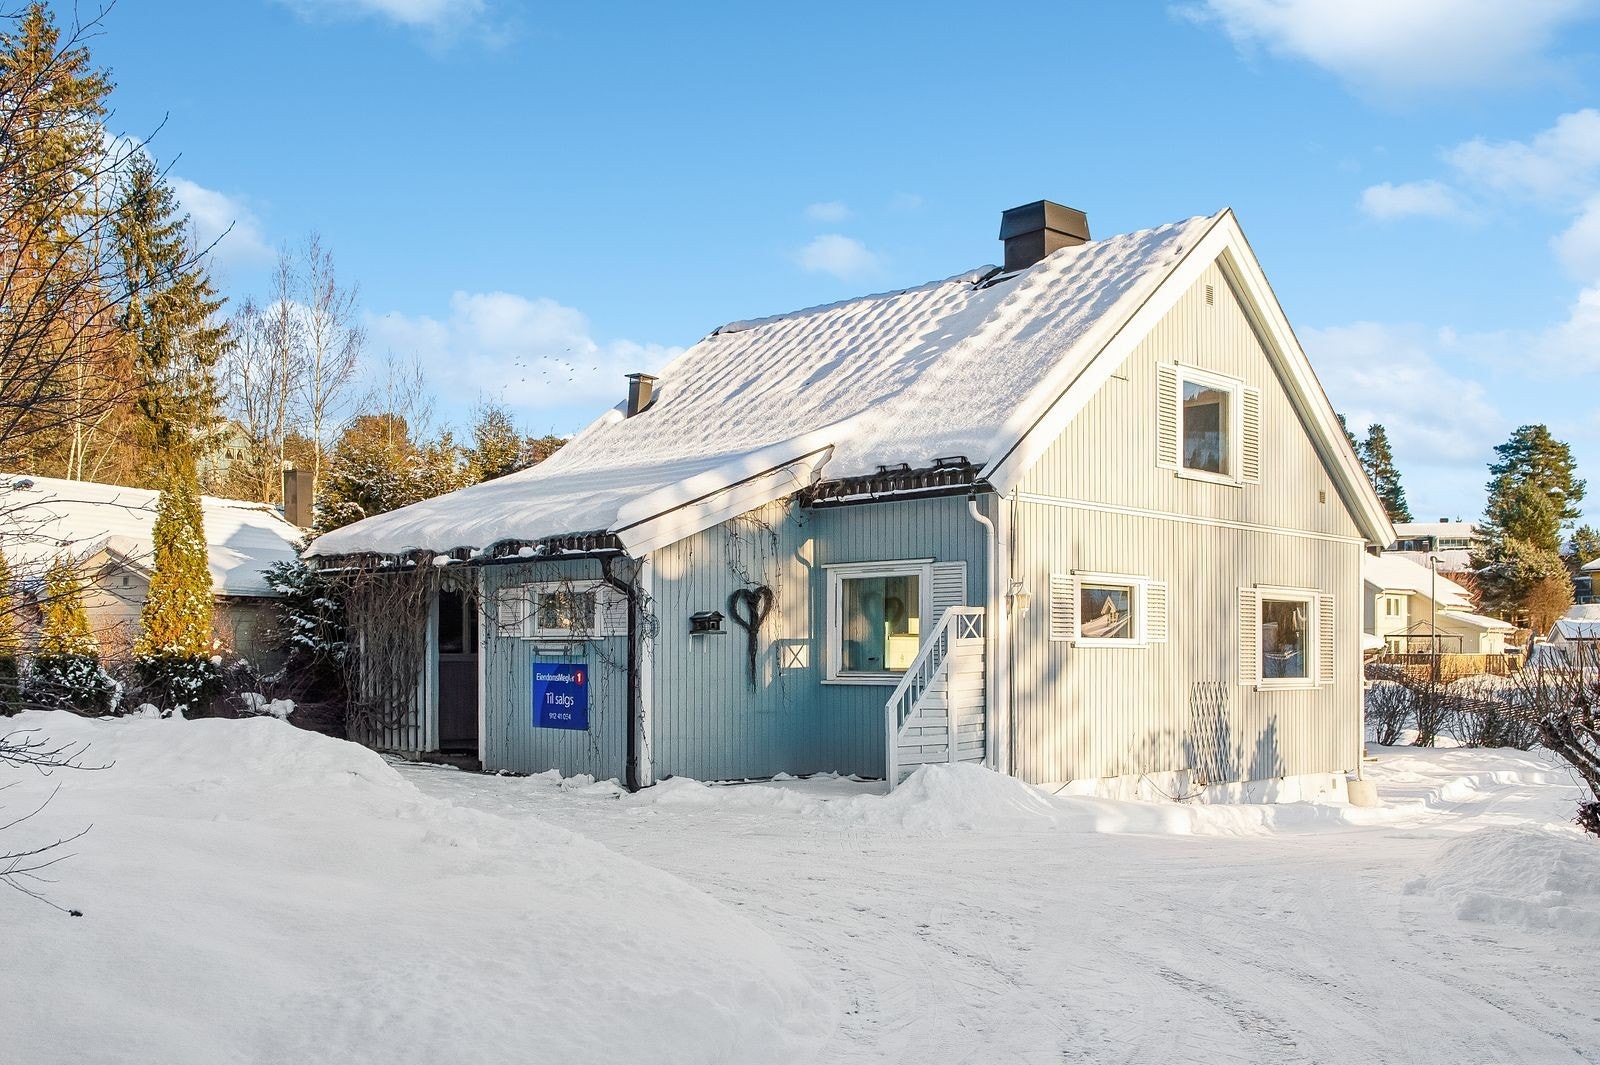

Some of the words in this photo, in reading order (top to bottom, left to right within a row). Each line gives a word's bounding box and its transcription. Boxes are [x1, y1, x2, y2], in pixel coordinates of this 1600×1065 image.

[577, 673, 581, 682] 1
[546, 692, 554, 704] Til
[555, 693, 574, 707] salgs
